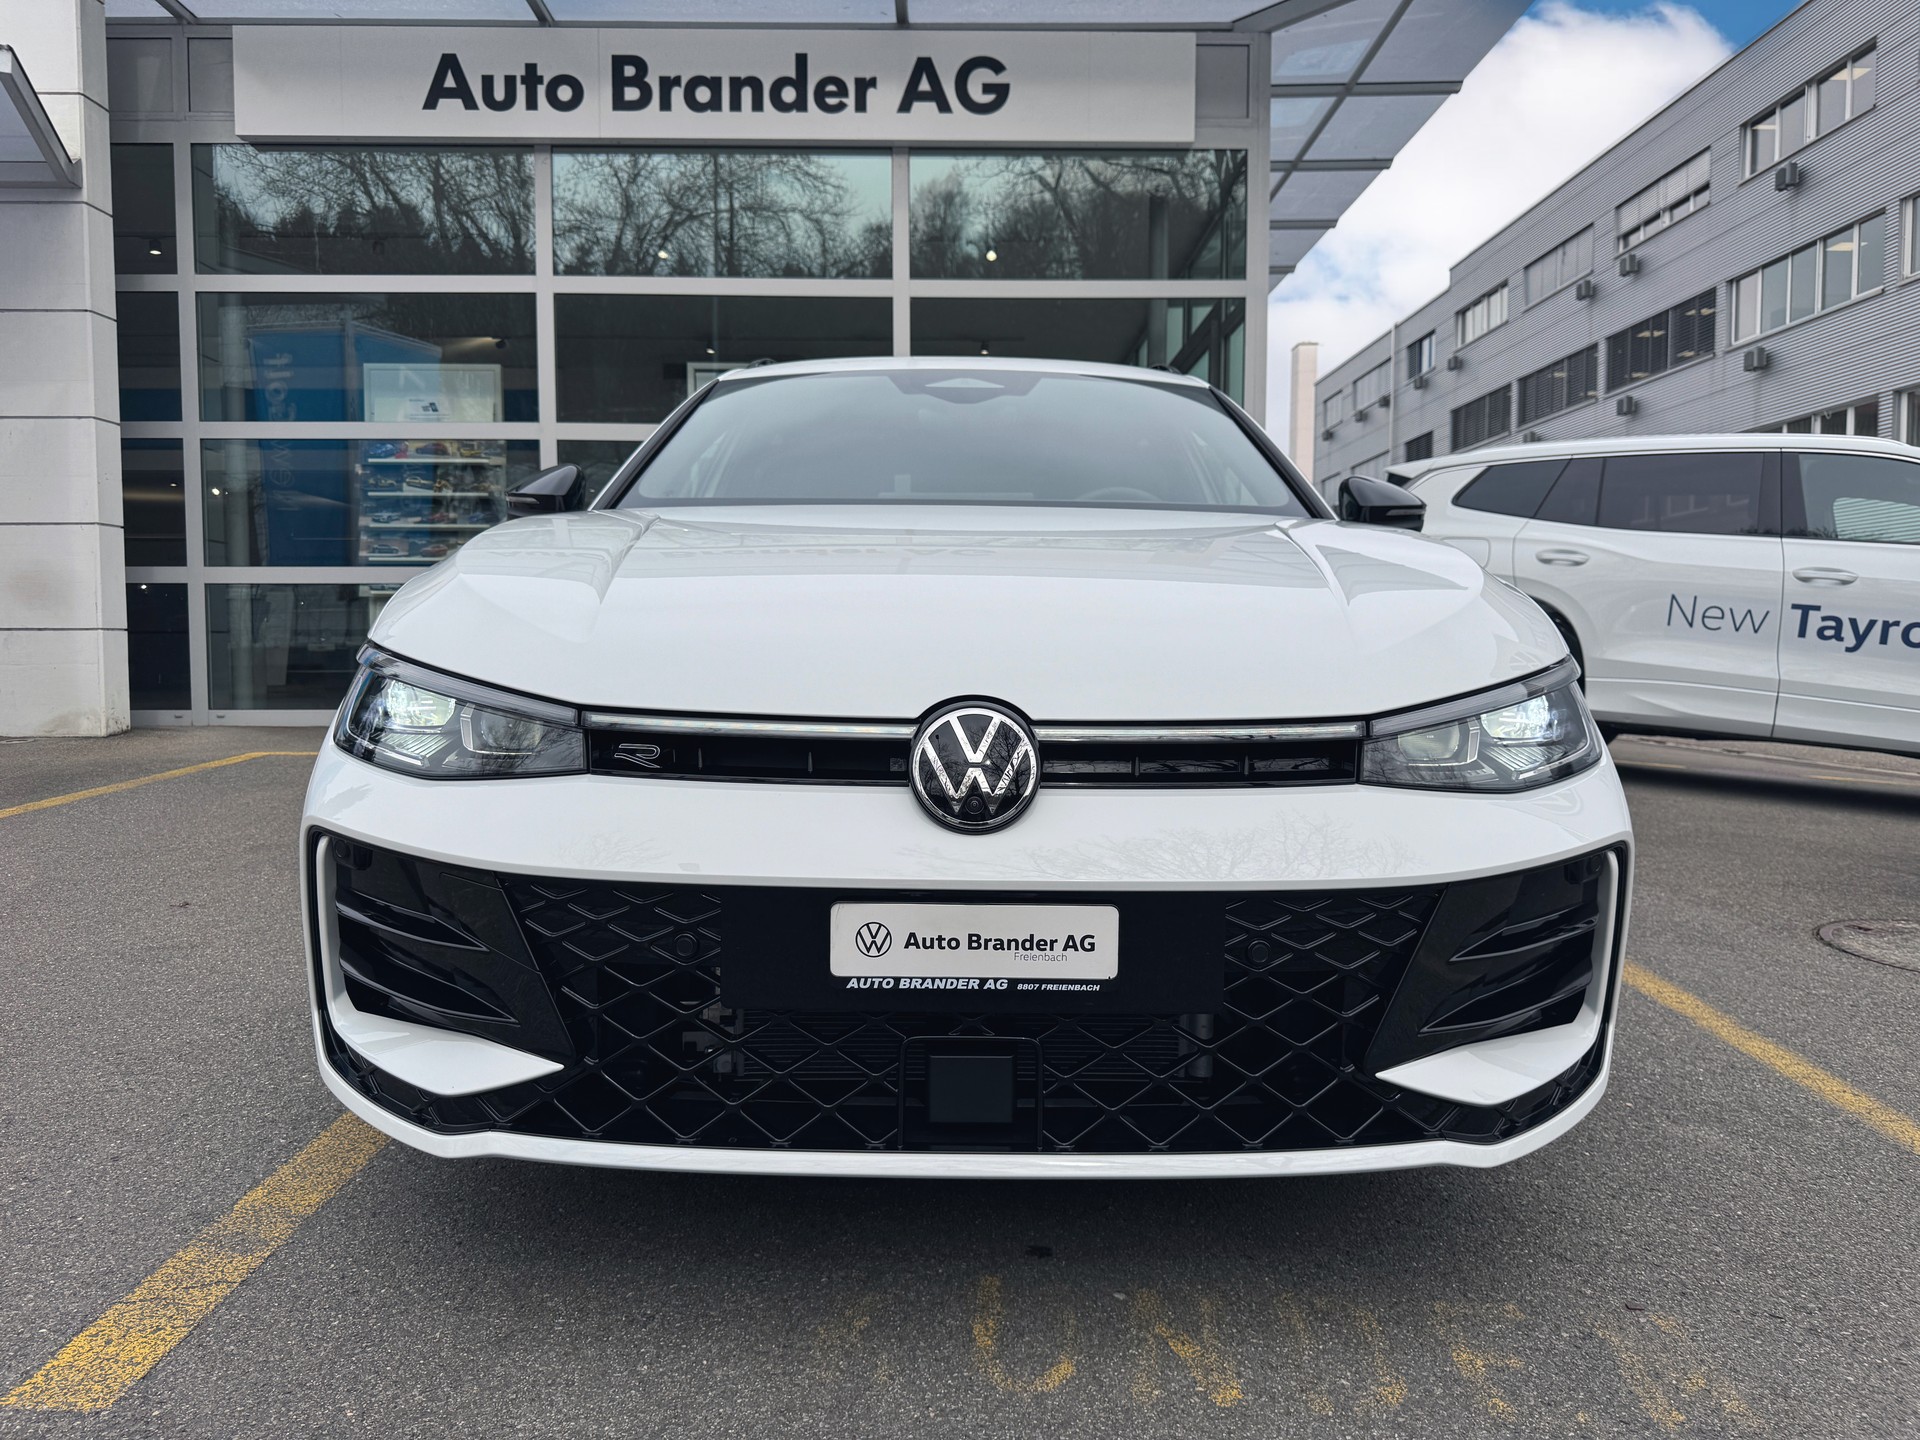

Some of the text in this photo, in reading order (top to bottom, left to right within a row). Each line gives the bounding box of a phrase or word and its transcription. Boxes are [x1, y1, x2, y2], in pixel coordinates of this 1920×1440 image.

[422, 52, 1011, 116] Auto Brander AG
[1667, 593, 1920, 653] New Tayro
[912, 707, 1037, 829] VW
[855, 921, 892, 958] VW
[904, 932, 1096, 952] Auto Brander AG
[1013, 952, 1068, 962] Freienbach
[846, 978, 894, 989] AUTO
[899, 978, 980, 990] BRANDER
[983, 979, 1009, 990] AG
[1016, 983, 1039, 991] 8807
